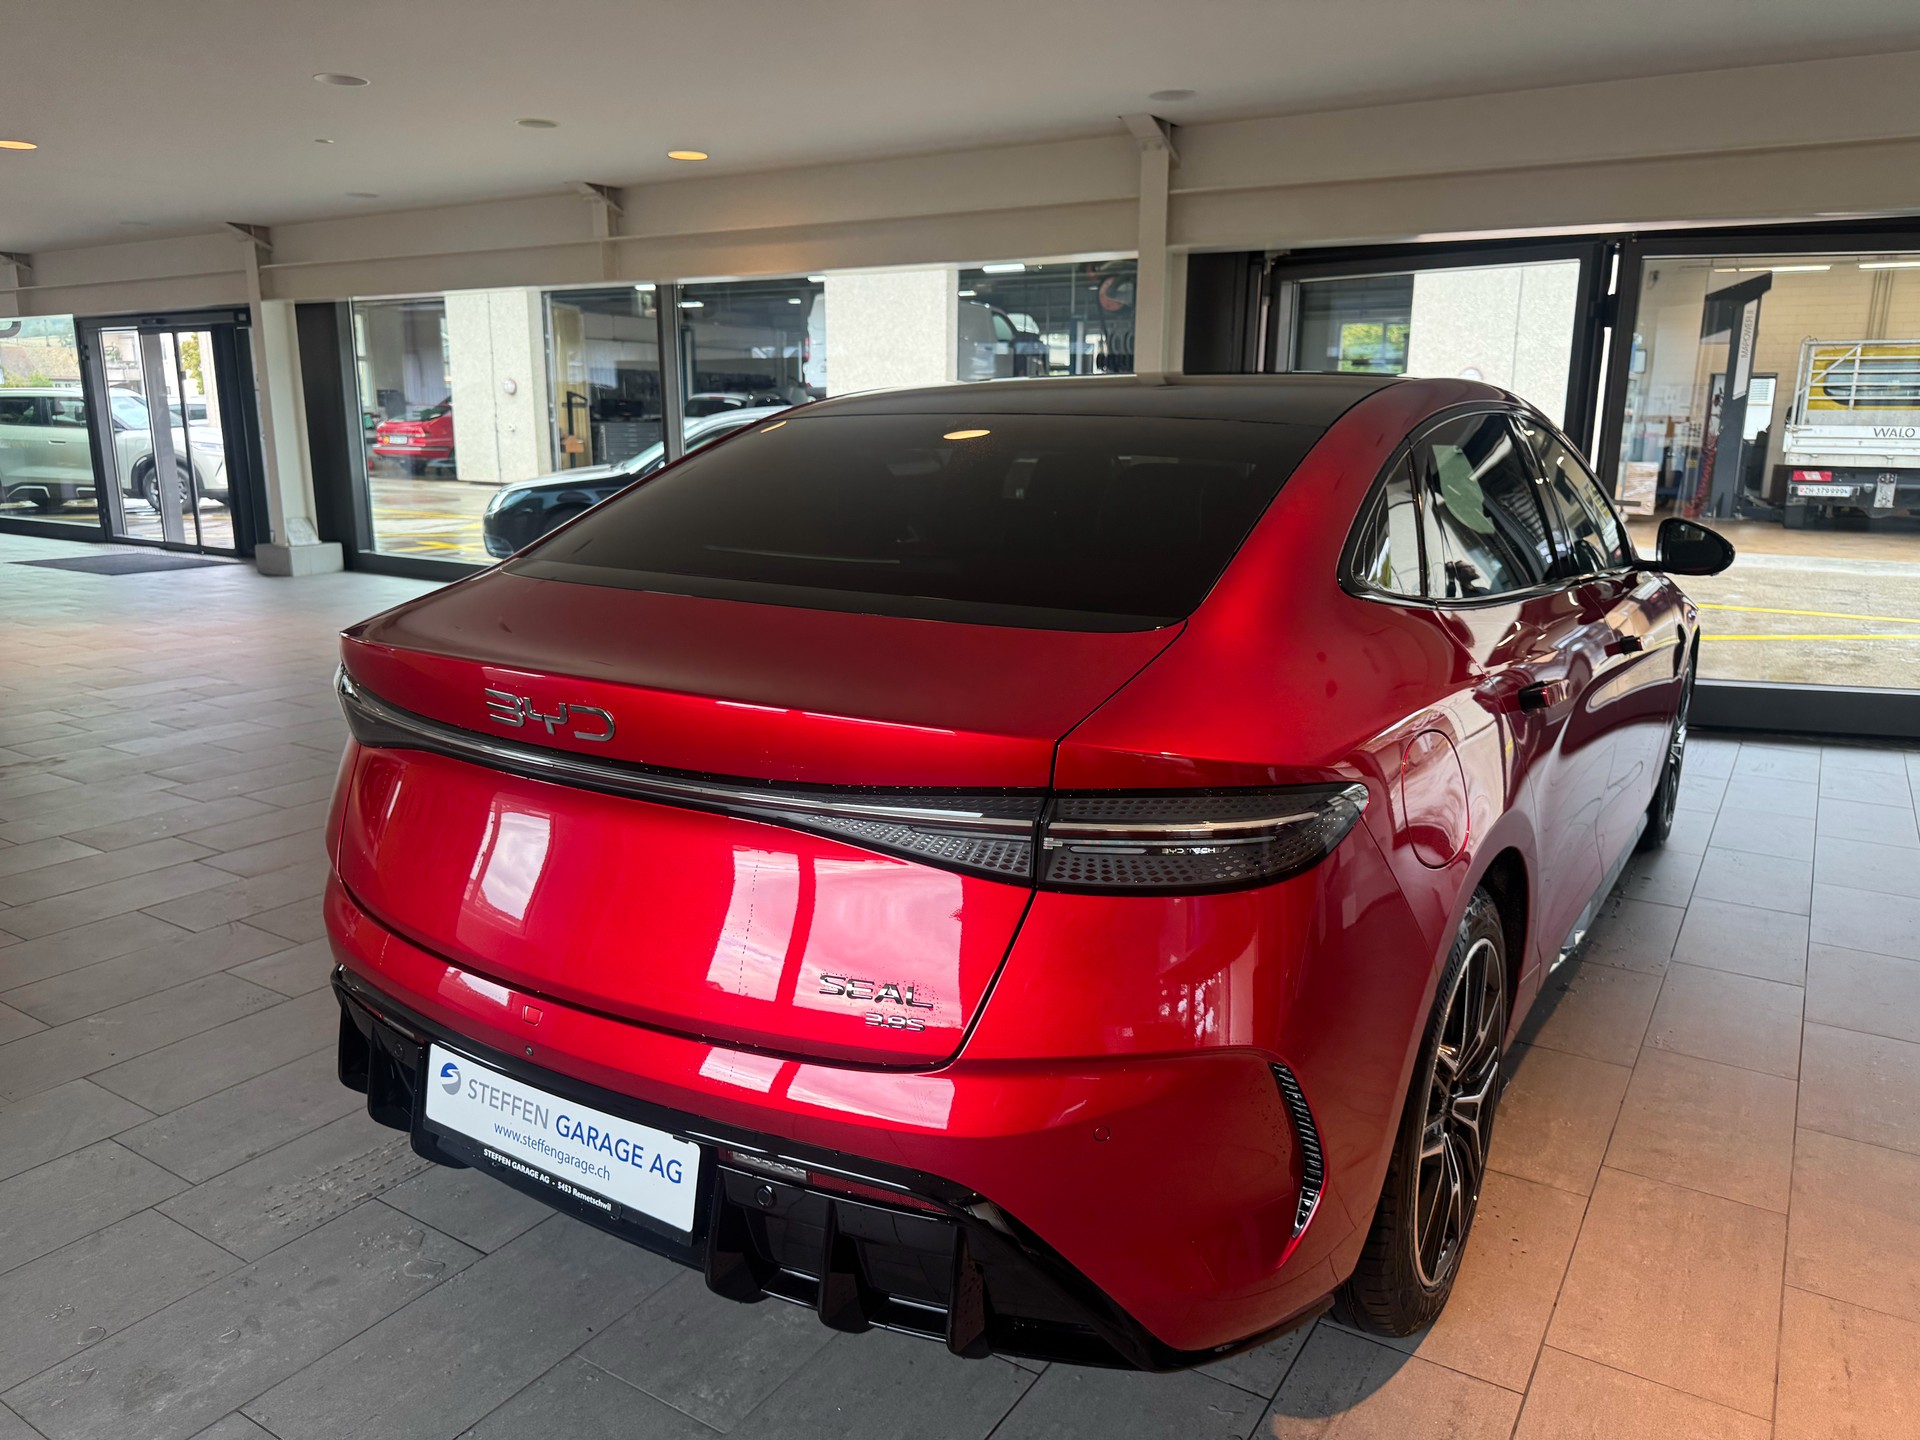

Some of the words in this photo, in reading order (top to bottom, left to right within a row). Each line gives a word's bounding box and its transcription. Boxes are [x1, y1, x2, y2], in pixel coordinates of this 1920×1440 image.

[1873, 427, 1916, 438] WALO
[484, 687, 616, 742] BYD
[819, 974, 934, 1010] SEAL
[468, 1079, 549, 1129] STEFFEN
[555, 1114, 644, 1169] GARAGE
[650, 1153, 683, 1184] AG
[493, 1122, 611, 1181] www.steffengarage.ch
[483, 1148, 511, 1168] STEFFEN
[511, 1161, 540, 1179] GARAGE
[540, 1172, 550, 1184] AG
[557, 1182, 572, 1194] 5453
[572, 1188, 612, 1212] Remetschwil
